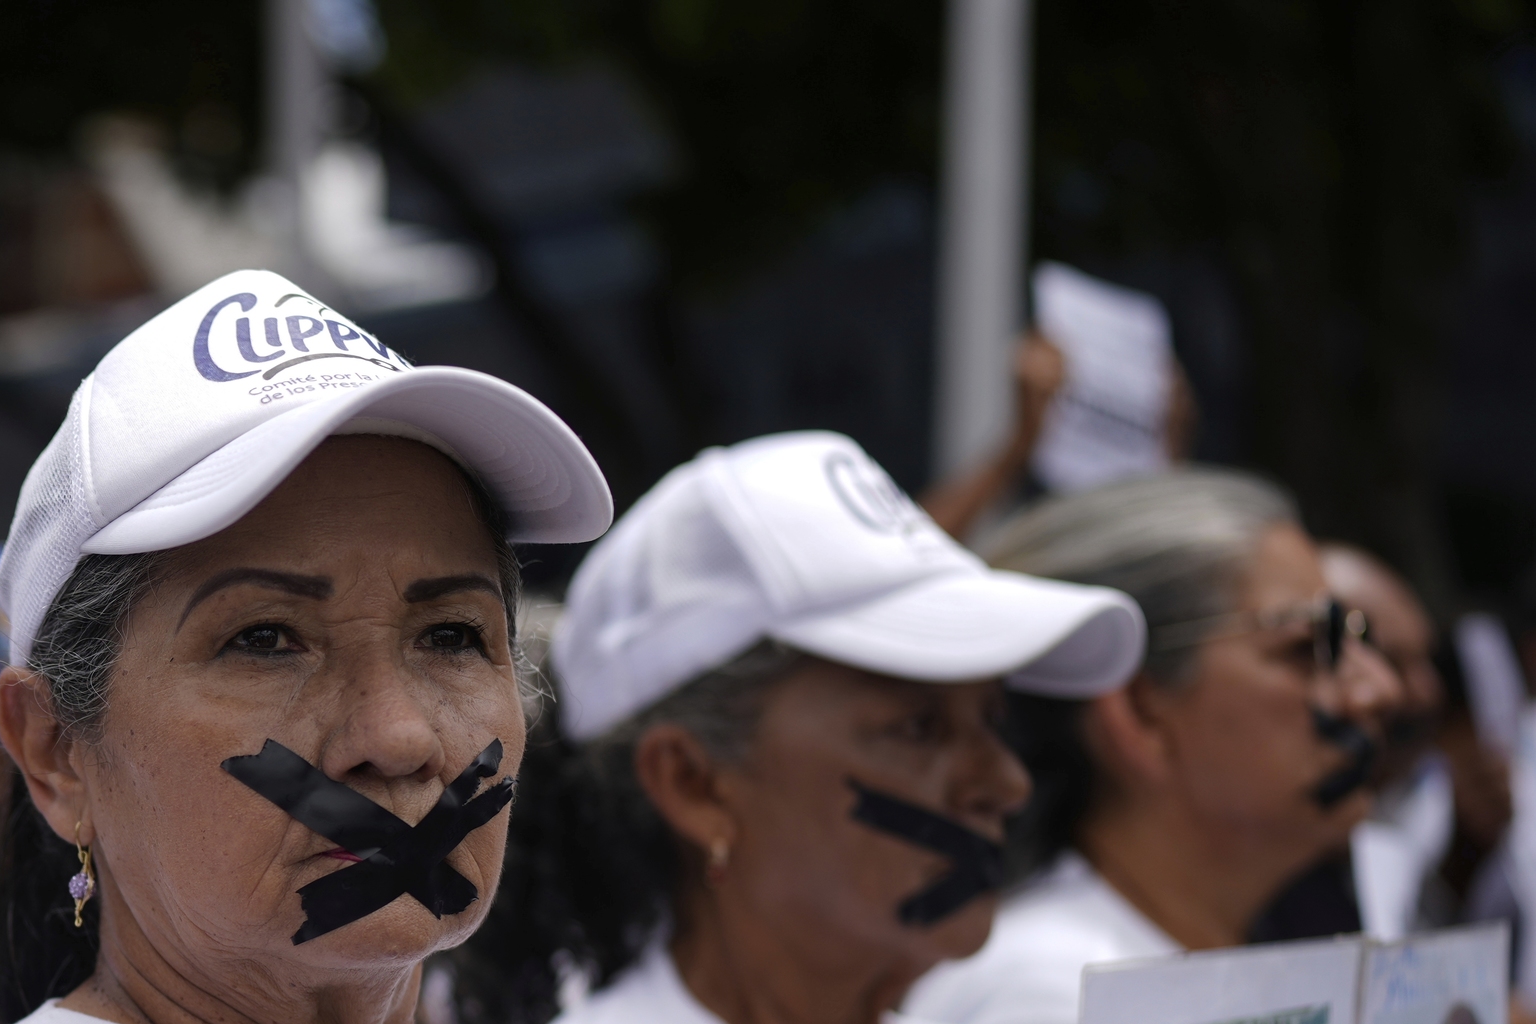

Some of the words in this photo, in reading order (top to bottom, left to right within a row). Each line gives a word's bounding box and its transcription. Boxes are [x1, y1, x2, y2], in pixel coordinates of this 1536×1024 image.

[249, 374, 317, 396] Comité
[321, 373, 351, 382] por
[355, 372, 372, 381] la
[260, 394, 284, 405] de
[287, 383, 315, 396] los
